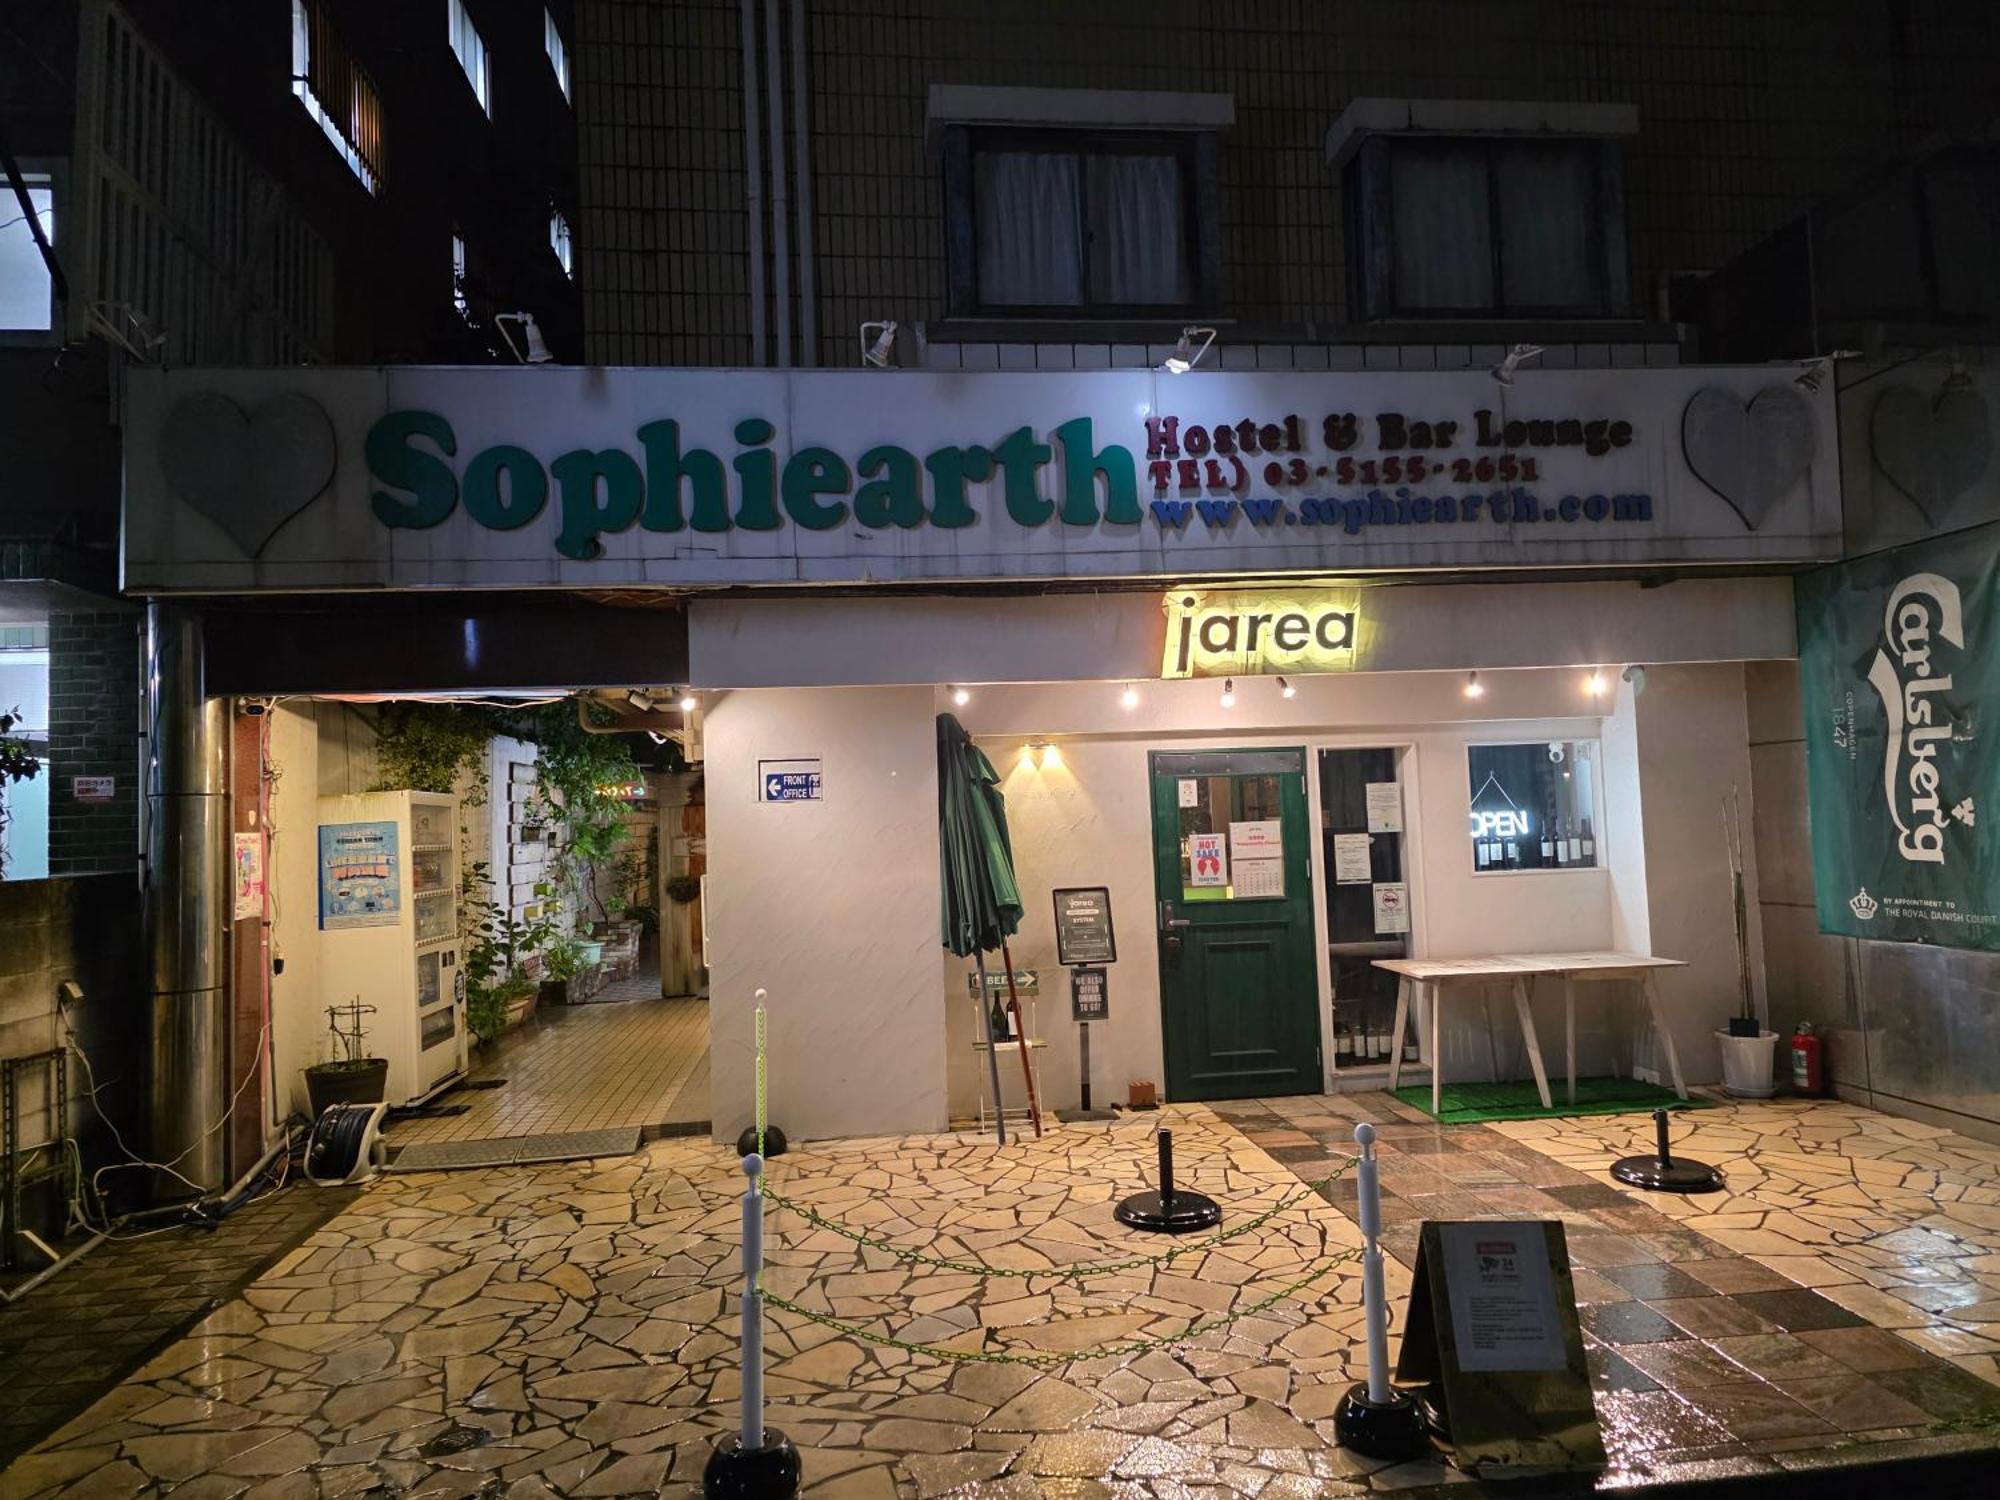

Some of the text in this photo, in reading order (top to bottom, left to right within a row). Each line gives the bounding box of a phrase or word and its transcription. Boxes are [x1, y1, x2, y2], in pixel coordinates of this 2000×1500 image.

[1144, 409, 1633, 457] Hostel & Bar Lounge
[365, 408, 1144, 560] Sophiearth
[1148, 456, 1248, 491] TEL)
[1150, 487, 1653, 535] www.sophiearth.com
[1176, 596, 1356, 672] jarea
[1831, 707, 1847, 748] 1847
[1845, 690, 1857, 760] COPENHAGEN
[1868, 572, 1964, 865] Carlsberg
[783, 775, 807, 785] FRONT
[783, 788, 807, 798] OFFICE
[1469, 810, 1529, 838] OPEN
[1196, 849, 1219, 857] SAKE
[1199, 840, 1216, 849] HOT
[1884, 907, 1997, 925] THE ROYAL DANISH COURT
[1894, 898, 1943, 908] APPOINTMENT
[1946, 901, 1956, 909] TO
